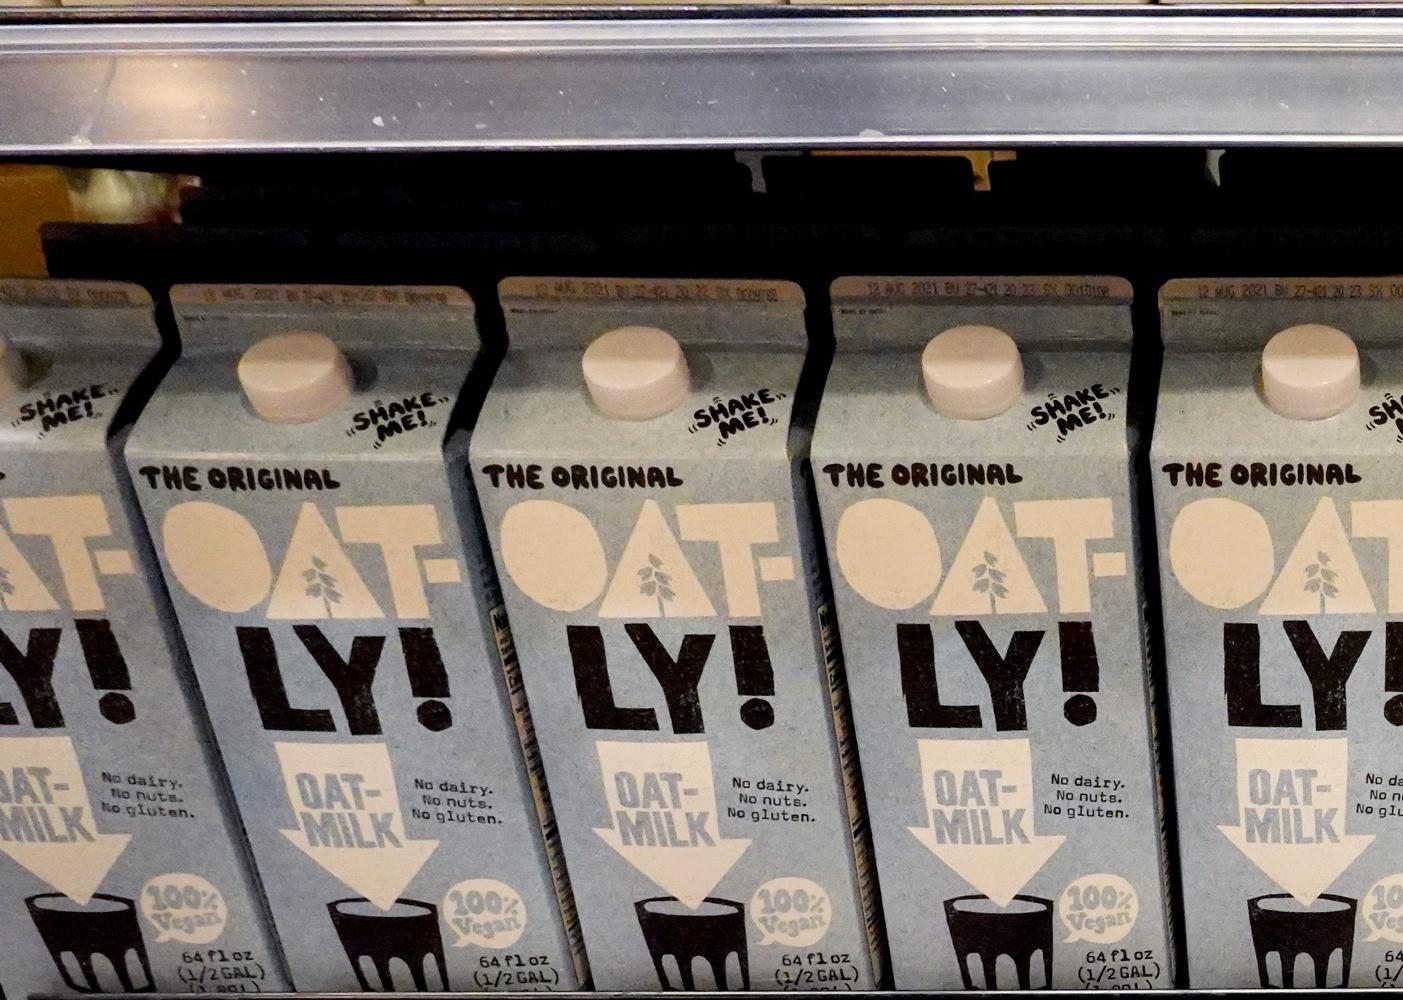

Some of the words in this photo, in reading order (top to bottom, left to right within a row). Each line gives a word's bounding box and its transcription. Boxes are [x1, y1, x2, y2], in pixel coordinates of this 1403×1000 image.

[1030, 383, 1110, 425] SHAKE
[1056, 402, 1106, 436] ME!
[822, 463, 884, 488] THE
[892, 463, 1022, 487] ORIGINAL
[1162, 463, 1222, 487] THE
[1231, 463, 1362, 487] ORIGINAL
[162, 501, 462, 619] OAT-
[836, 497, 1126, 616] OAT-
[235, 623, 453, 736] LY!
[896, 620, 1100, 731] LY!
[934, 769, 1018, 807] OAT-
[1051, 774, 1069, 787] No
[1074, 776, 1126, 791] dairy.
[1056, 789, 1074, 802] No
[1079, 791, 1123, 804] nuts.
[1044, 804, 1061, 816] No
[1067, 805, 1129, 820] gluten.
[935, 809, 1030, 845] MILK
[1068, 885, 1132, 911] 100%
[1067, 910, 1132, 935] Vegan
[1086, 951, 1105, 963] 64
[1110, 950, 1130, 962] fl
[1134, 951, 1153, 962] oz
[1077, 963, 1116, 984] (1/2
[1119, 963, 1160, 980] GAL)
